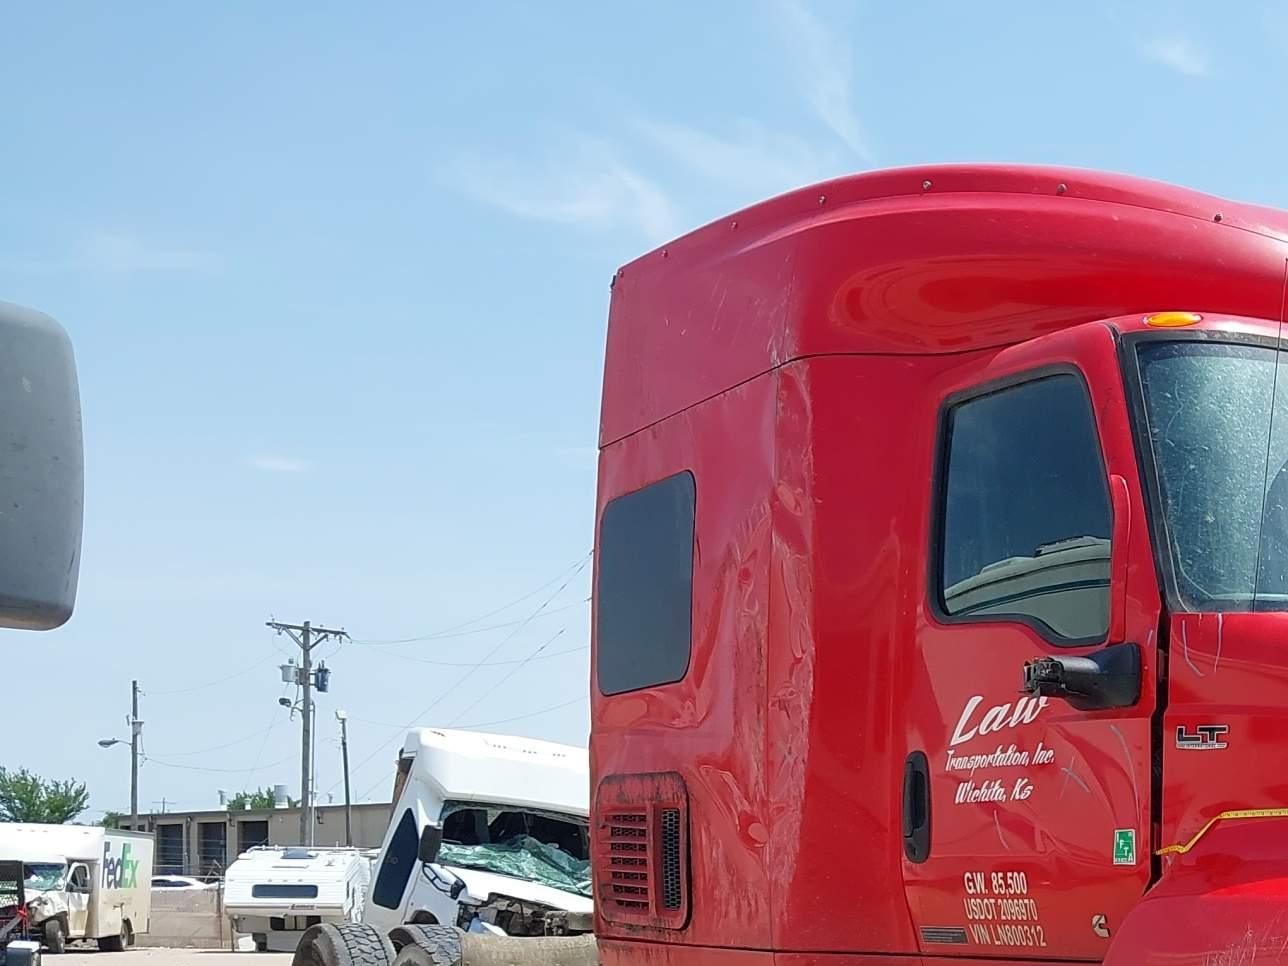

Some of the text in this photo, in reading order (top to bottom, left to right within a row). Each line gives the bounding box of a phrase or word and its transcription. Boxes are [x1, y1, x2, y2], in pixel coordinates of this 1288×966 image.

[950, 695, 1049, 746] Law
[1176, 725, 1229, 744] LT
[945, 742, 1055, 777] Transportation, Inc.
[955, 778, 1034, 804] Wichita, Ks
[102, 841, 139, 889] FedEx
[991, 871, 1028, 898] 85,500
[963, 898, 1038, 921] USDOT 2096970
[969, 924, 991, 945] VIN
[990, 924, 1047, 946] LN800312
